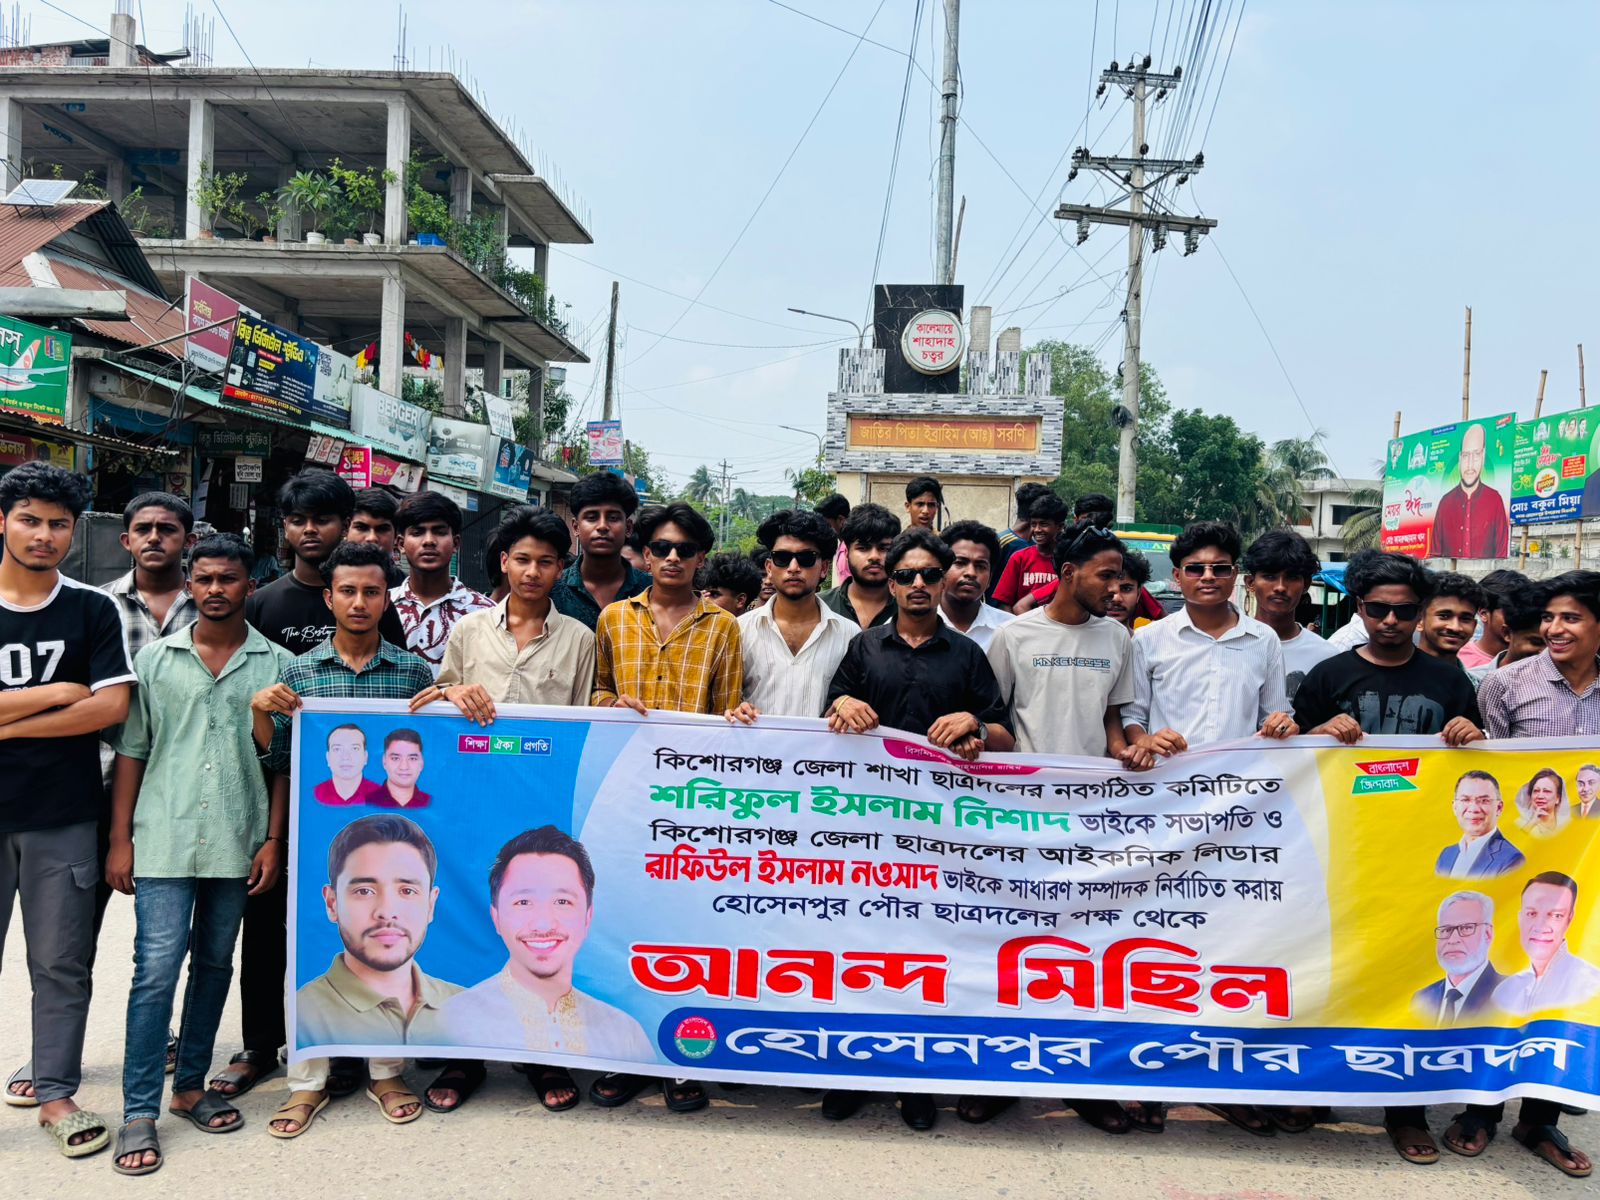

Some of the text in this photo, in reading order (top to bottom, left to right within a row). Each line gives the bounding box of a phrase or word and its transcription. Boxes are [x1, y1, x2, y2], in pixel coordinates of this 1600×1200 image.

[252, 324, 282, 354] ডিজিটাল
[916, 323, 953, 336] কালেমায়ে
[912, 337, 955, 349] শাহাদাহ
[922, 350, 944, 364] চত্বর
[377, 397, 418, 425] BERGER
[860, 422, 1026, 445] জাতির পিতা ইব্রাহিম (আঃ) সরণি
[1511, 494, 1581, 513] মোঃ বকুল মিয়া
[281, 626, 300, 643] The
[465, 736, 549, 752] শিক্ষা ঐক্য প্রগতি
[653, 748, 1284, 799] কিশোরগঞ্জ জেলা শাখা ছাত্রদলের নবগঠিত কমিটিতে
[1368, 760, 1410, 774] বাংলাদেশ
[1360, 778, 1400, 790] জিন্দাবাদ
[650, 777, 1283, 835] শরিফুল ইসলাম নিশাদ ভাইকে সভাপতি ও
[649, 819, 1283, 867] কিশোরগঞ্জ জেলা ছাত্রদলের আইকনিক লিডার
[645, 843, 1283, 902] রাফিউল ইসলাম নওসাদ ভাইকে সাধারণ সম্পাদক নির্বাচিত করায়
[712, 893, 1209, 929] হোসেনপুর পৌর ছাত্রদলের পক্ষ থেকে
[629, 935, 1293, 1020] আনন্দ মিছিল
[726, 1026, 1101, 1076] হোসেনপুর
[1129, 1030, 1312, 1075] পৌর
[1330, 1036, 1586, 1080] ছাত্রদল
